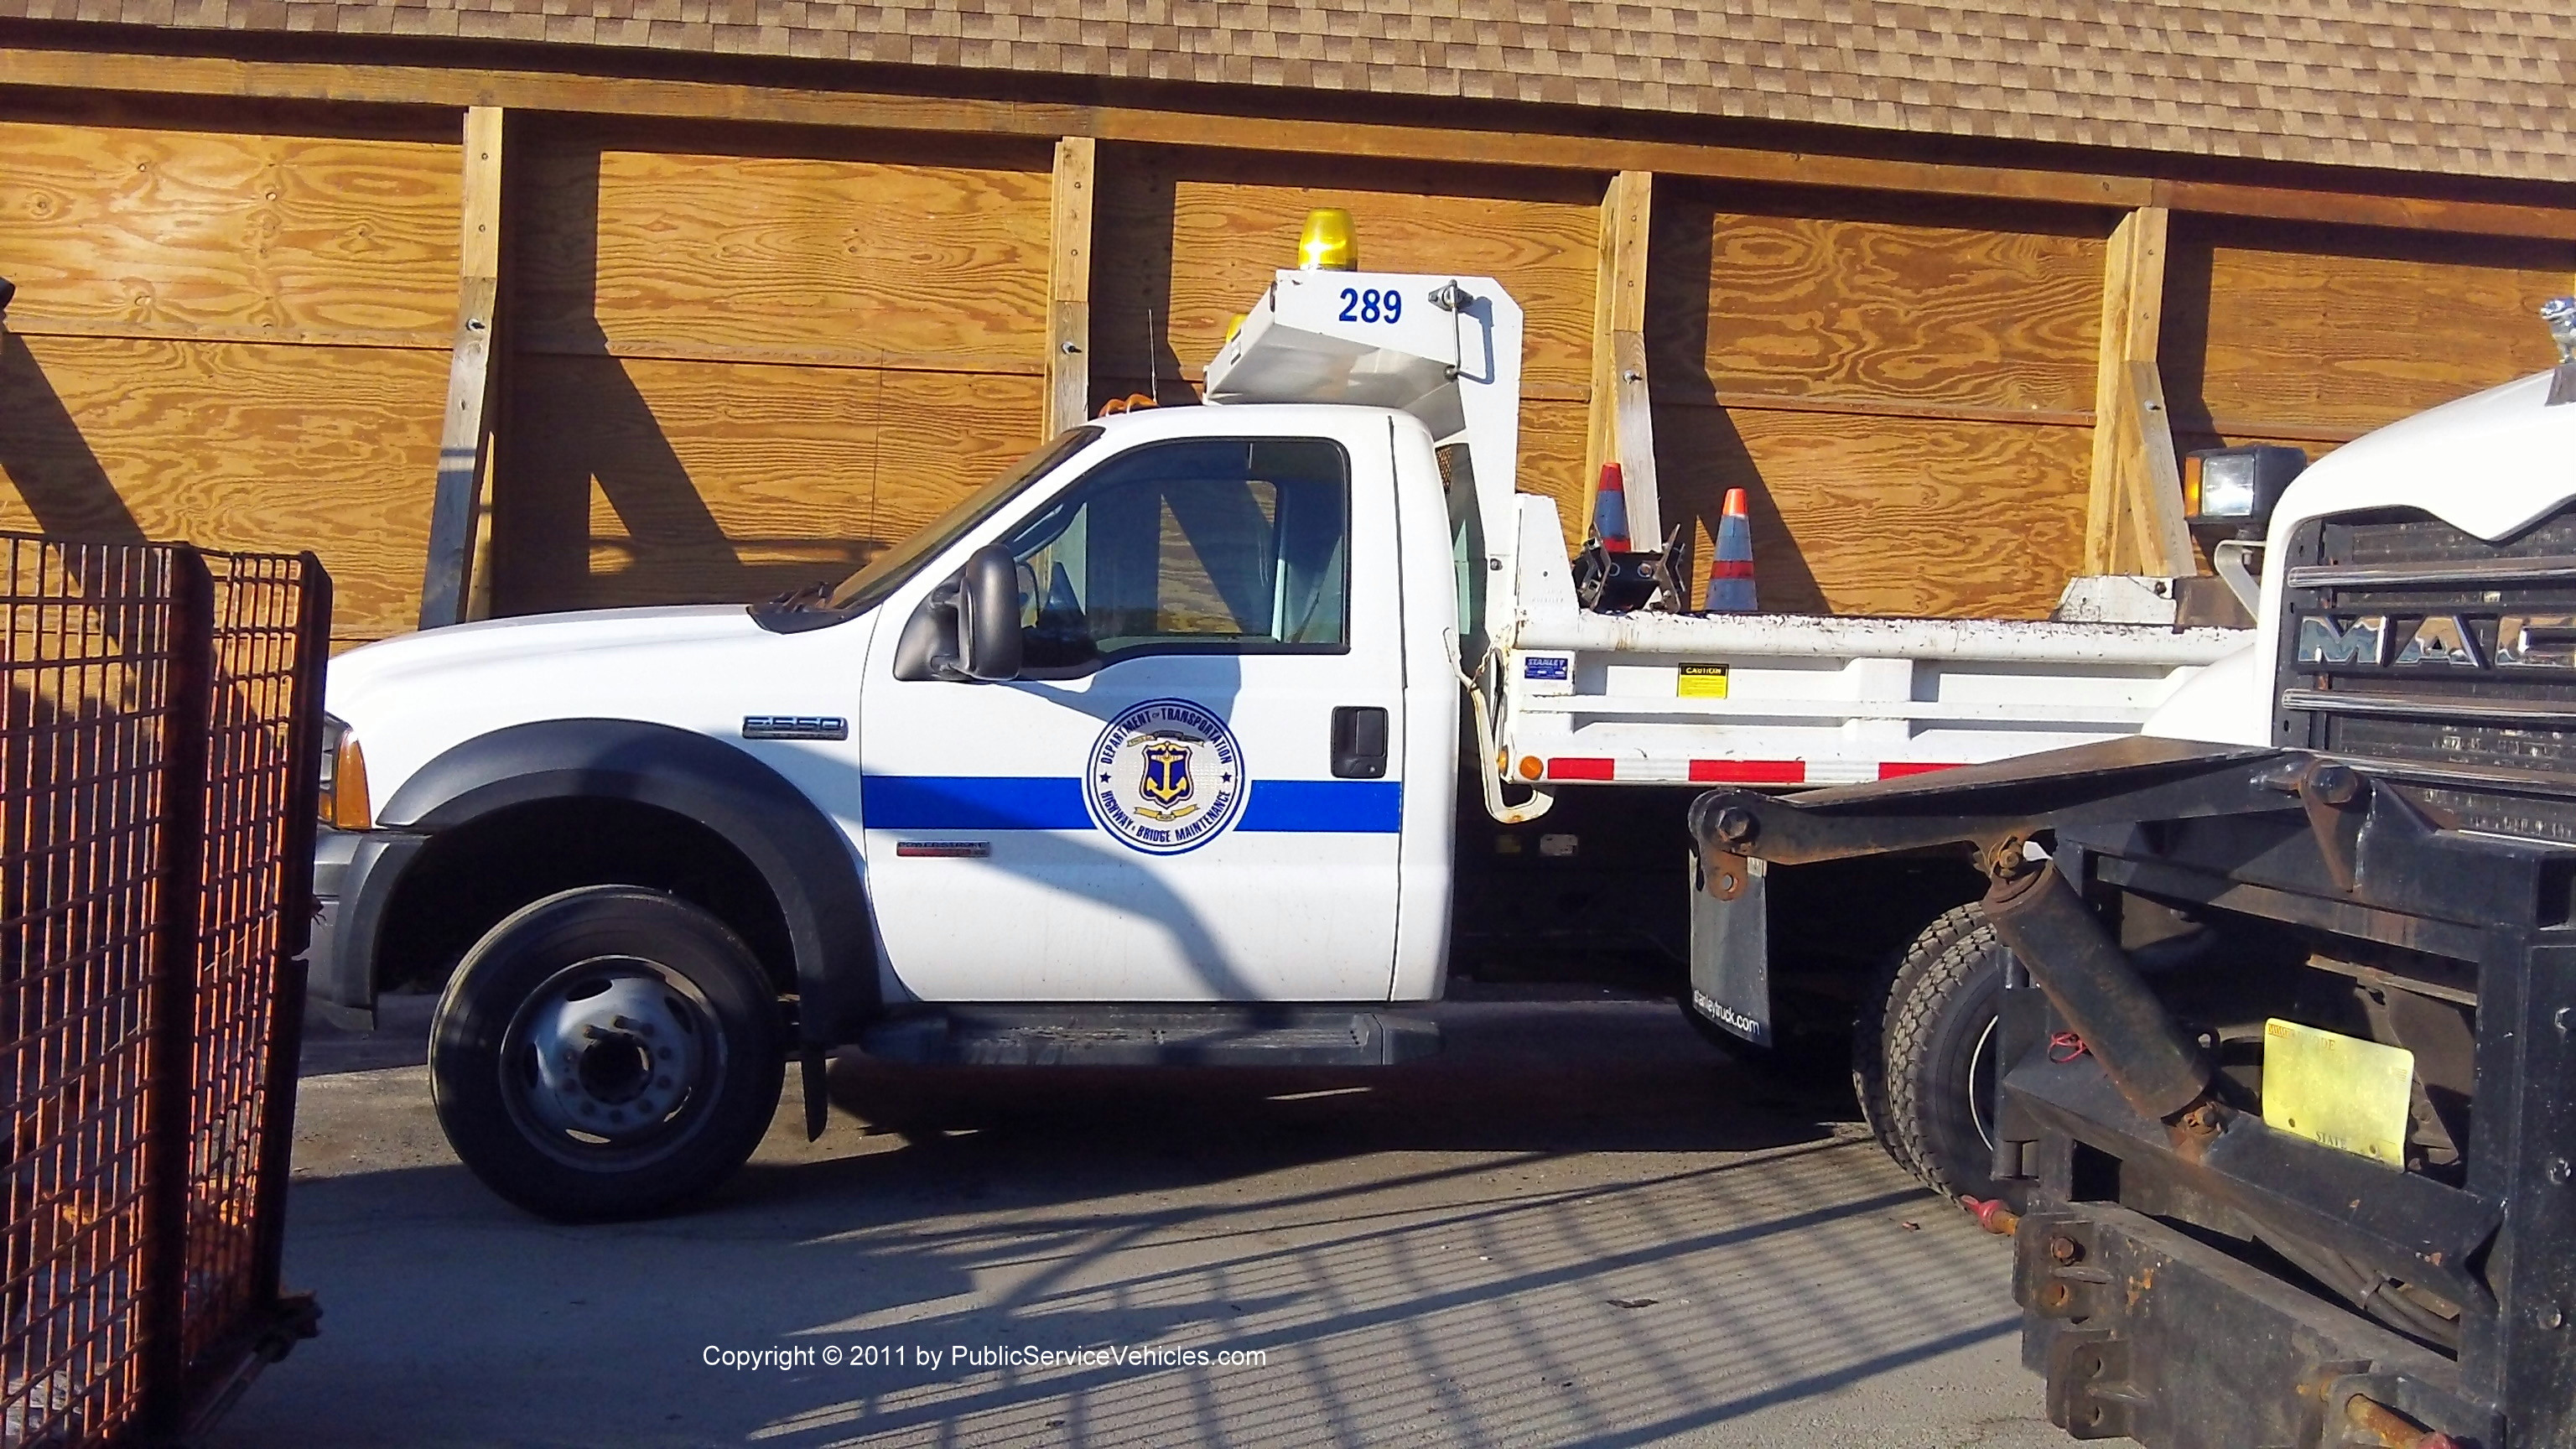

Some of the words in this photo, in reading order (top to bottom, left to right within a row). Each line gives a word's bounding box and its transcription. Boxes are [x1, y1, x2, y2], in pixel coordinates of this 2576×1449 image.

[1338, 288, 1402, 325] 289
[2298, 615, 2576, 669] MAC
[1100, 710, 1152, 765] DEPARTMENT
[1161, 708, 1233, 765] TRANSPORTATION
[1100, 790, 1133, 830] HIGHWAY
[1135, 825, 1171, 843] BRIDGE
[1175, 789, 1231, 841] MAINTENANCE
